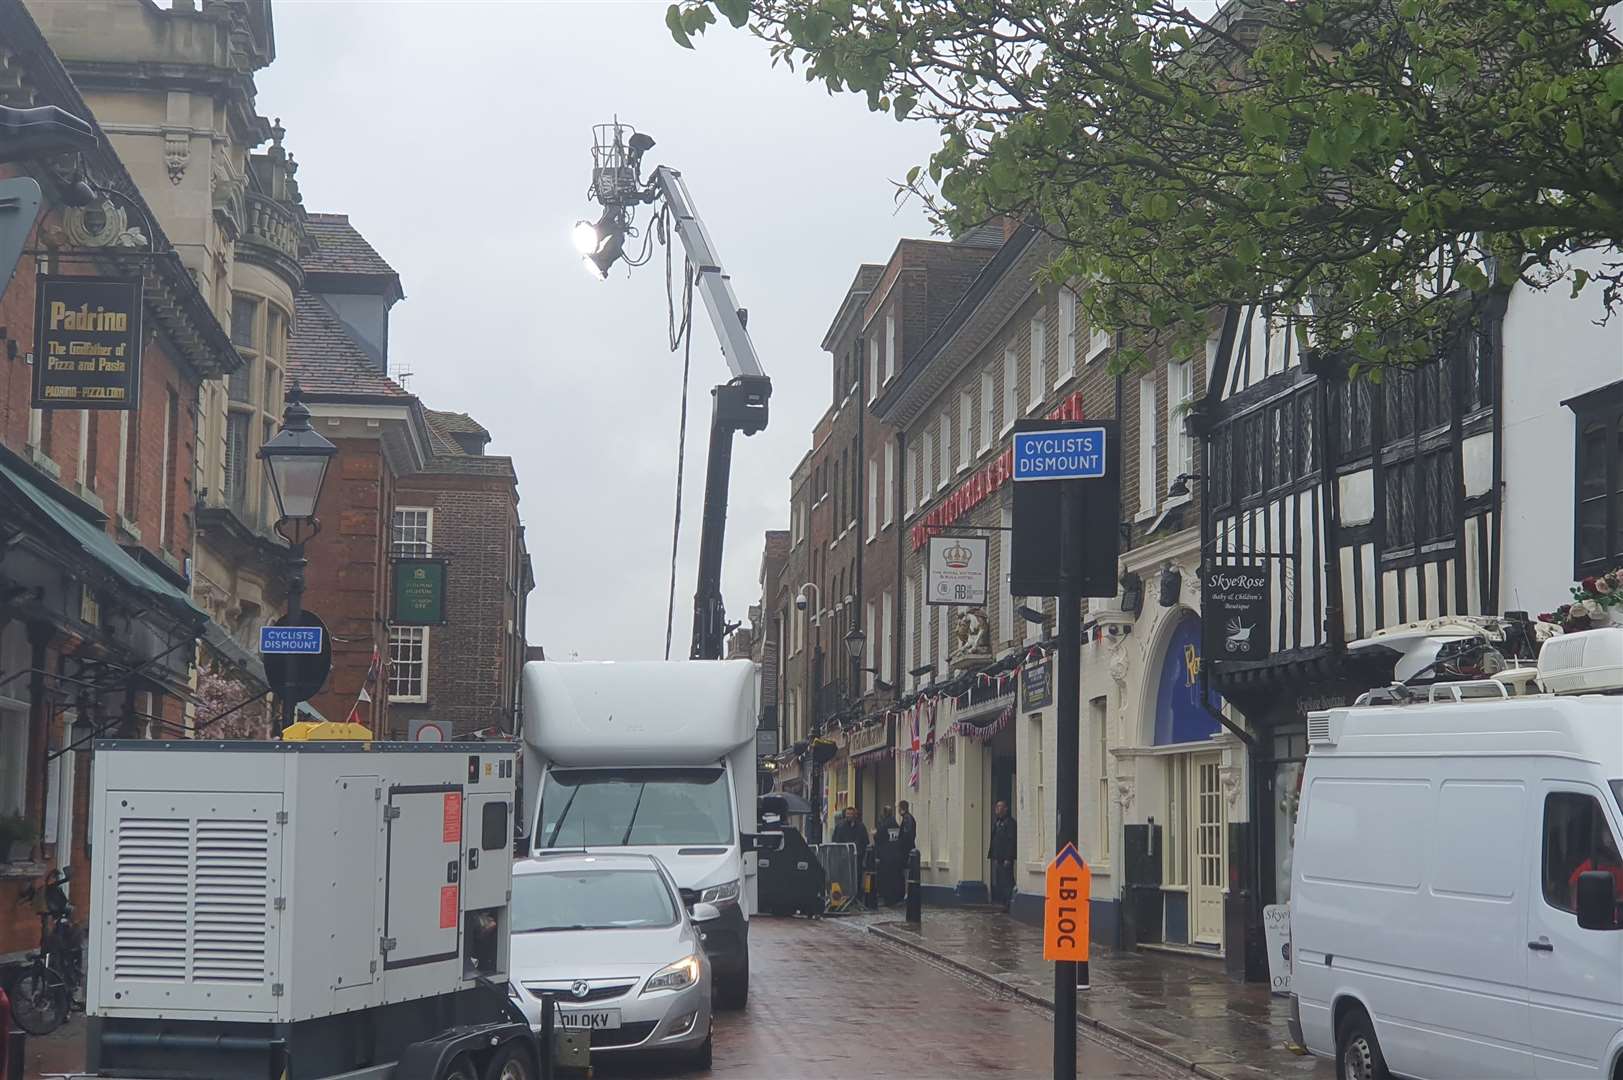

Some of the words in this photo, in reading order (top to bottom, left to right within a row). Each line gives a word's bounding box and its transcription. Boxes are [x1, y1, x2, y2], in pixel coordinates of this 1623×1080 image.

[50, 301, 127, 331] Padrino
[48, 341, 66, 355] The
[115, 343, 126, 356] of
[48, 356, 75, 371] Pizza
[78, 358, 95, 371] and
[98, 358, 126, 372] Pasta
[1025, 438, 1093, 455] CYCLISTS
[1020, 455, 1098, 472] DISMOUNT
[268, 631, 314, 640] CYCLISTS
[264, 640, 318, 649] DISMOUNT
[1059, 876, 1078, 901] LB
[1057, 907, 1076, 949] LOC
